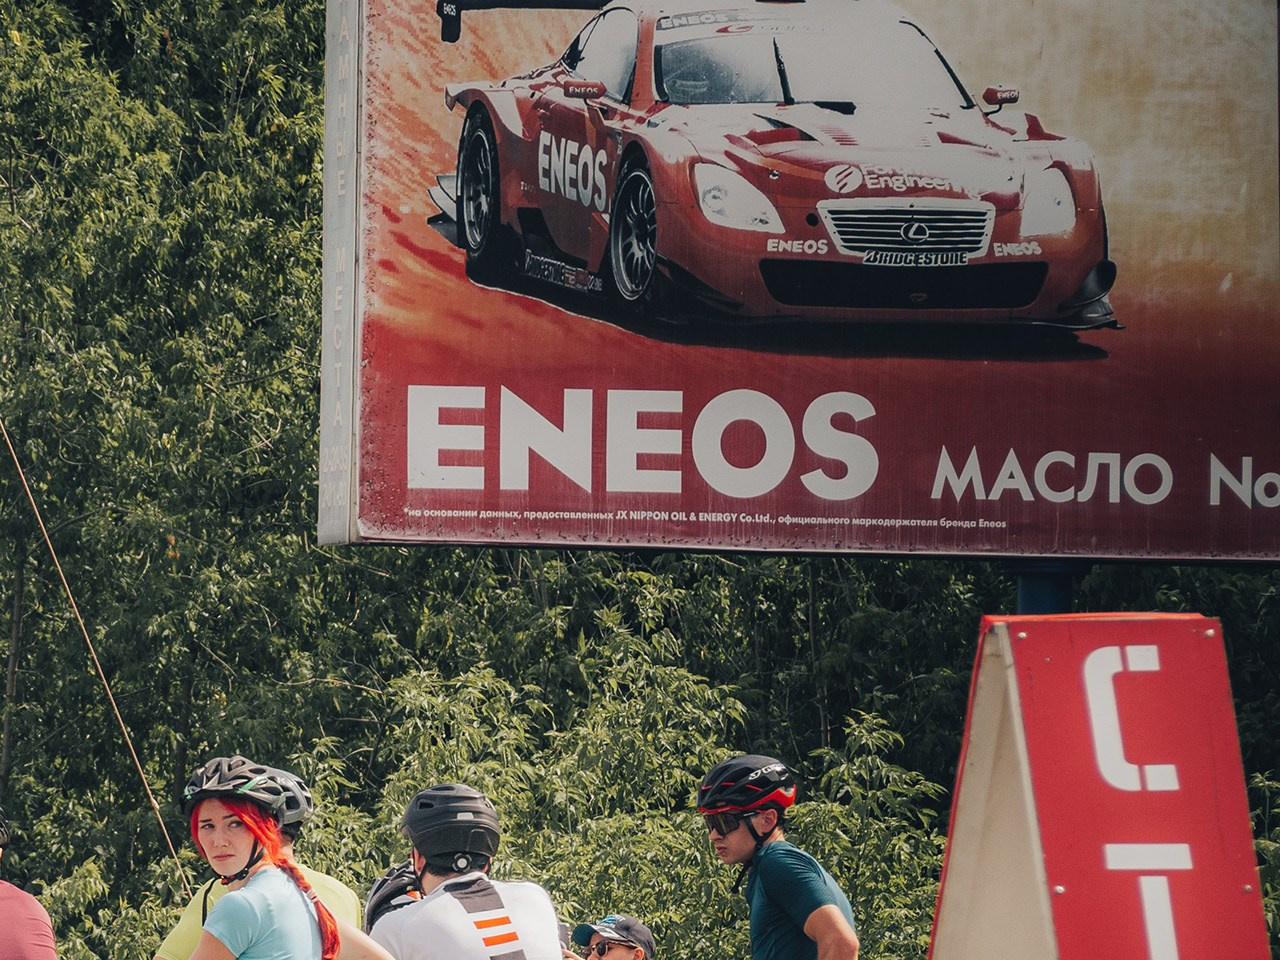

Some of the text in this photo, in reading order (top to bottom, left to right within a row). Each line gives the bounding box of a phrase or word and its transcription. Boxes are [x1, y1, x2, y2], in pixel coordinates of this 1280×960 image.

[538, 130, 608, 212] ENEOS
[767, 239, 829, 254] ENEOS
[993, 242, 1043, 256] ENEOS
[863, 250, 969, 267] BRIDGESTONE
[407, 385, 880, 500] ENEOS
[930, 444, 1174, 505] МАСЛО
[423, 509, 478, 518] основании
[479, 510, 522, 519] данных,
[523, 510, 614, 521] предоставленных
[615, 510, 628, 520] JX
[629, 510, 670, 521] NIPPON
[671, 511, 688, 521] OIL
[689, 512, 697, 521] &
[698, 512, 738, 522] ENERGY
[778, 515, 850, 525] официального
[851, 517, 938, 527] маркодержателя
[939, 517, 977, 528] бренда
[978, 518, 1007, 528] Eneos
